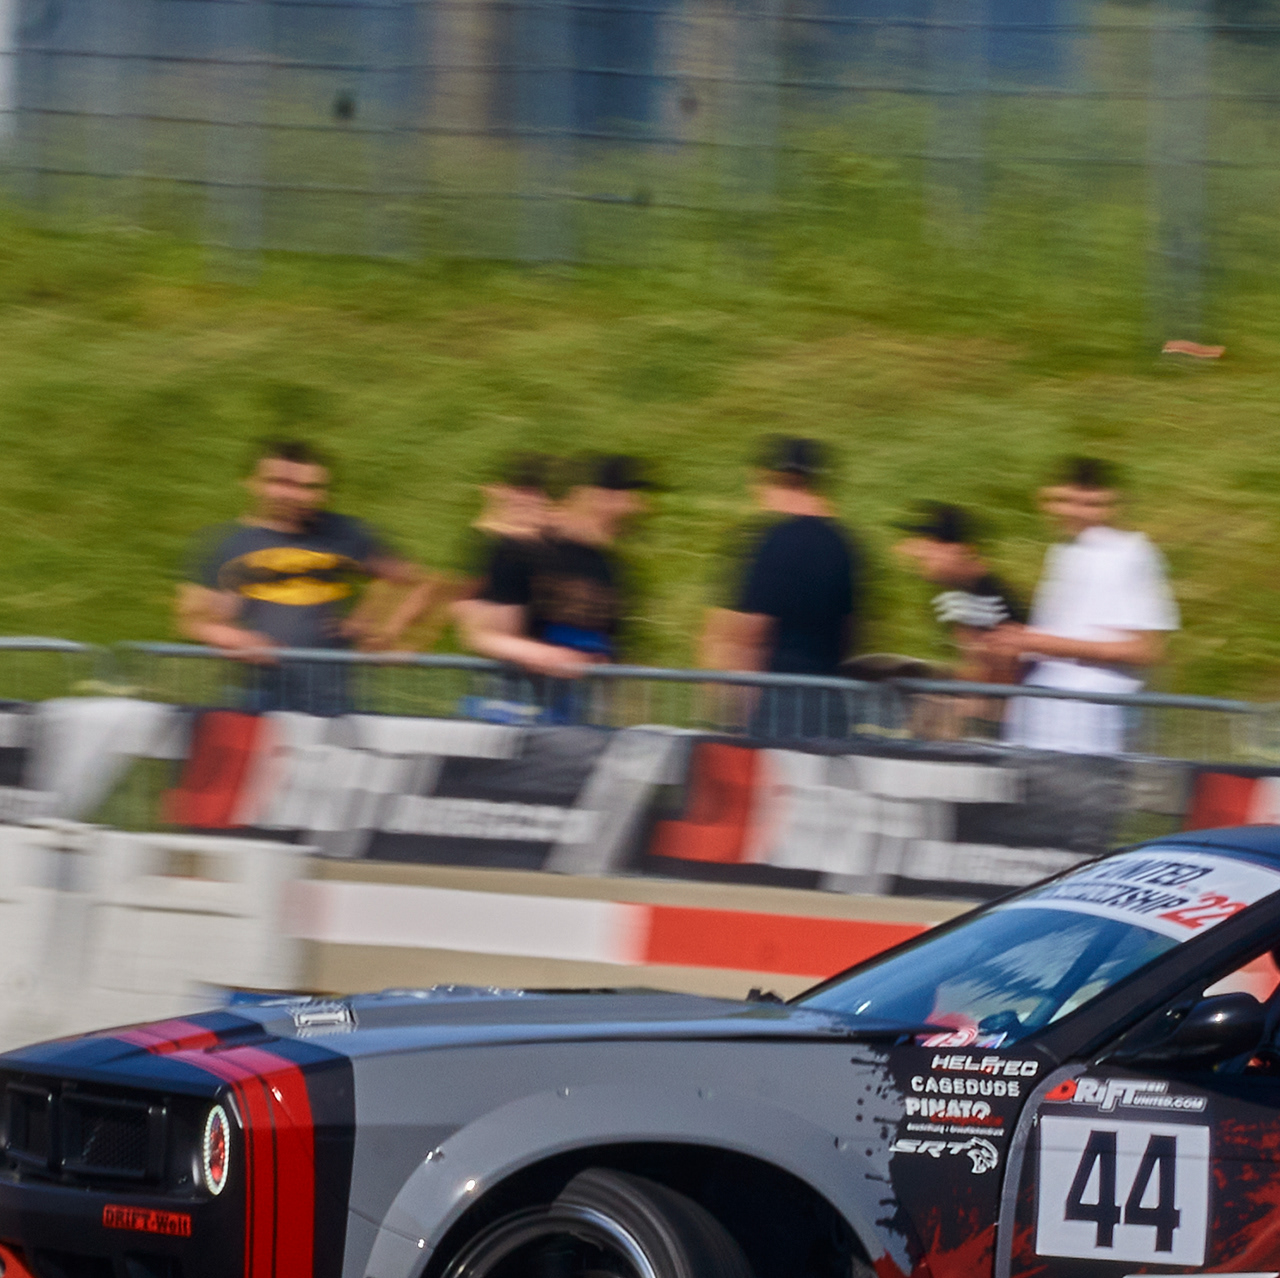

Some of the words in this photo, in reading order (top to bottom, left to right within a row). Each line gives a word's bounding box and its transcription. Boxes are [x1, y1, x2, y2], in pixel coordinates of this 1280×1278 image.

[911, 1075, 1020, 1097] CAGEDUDE
[889, 1138, 974, 1158] SRT
[1064, 1129, 1181, 1253] 44
